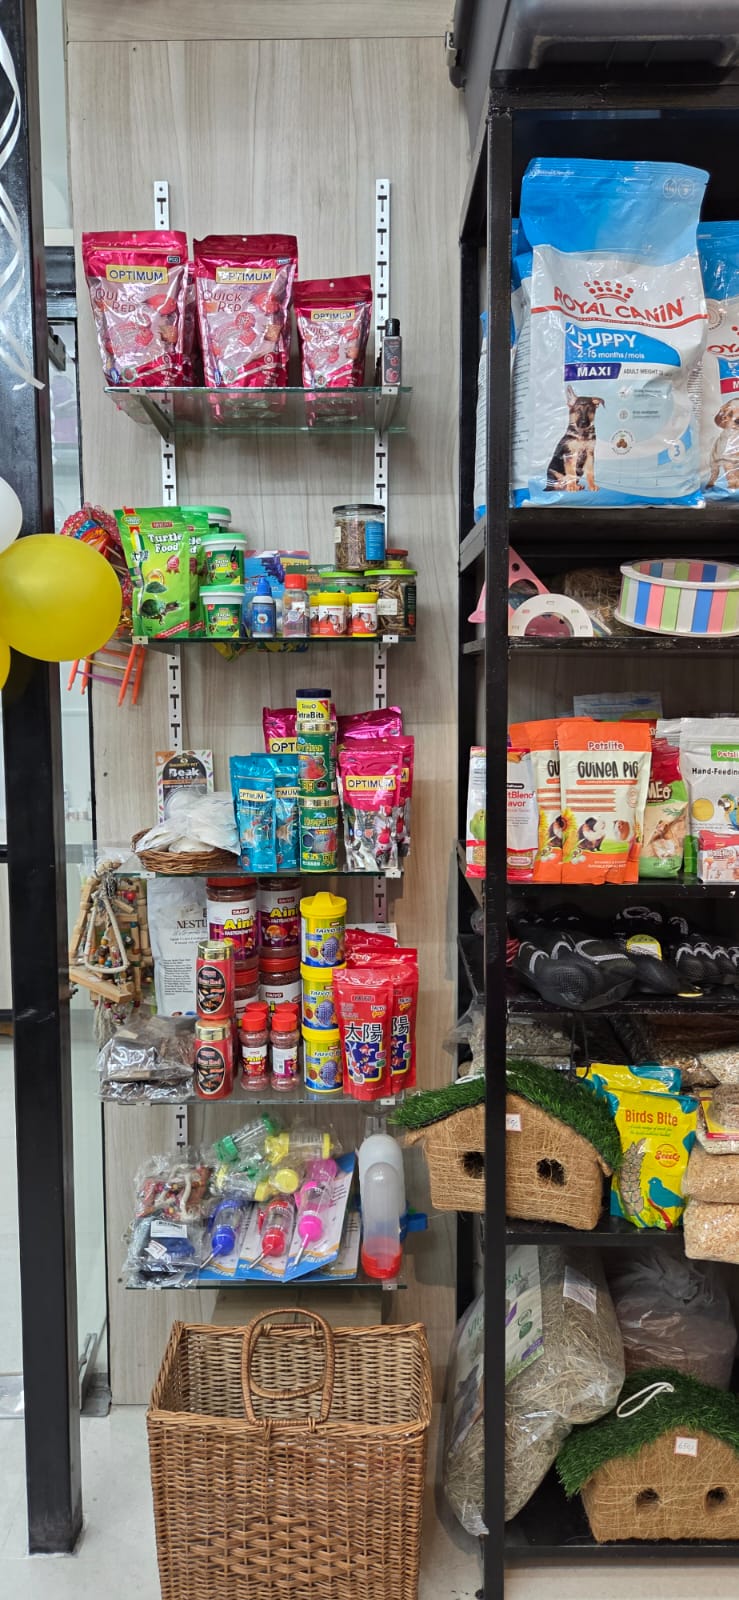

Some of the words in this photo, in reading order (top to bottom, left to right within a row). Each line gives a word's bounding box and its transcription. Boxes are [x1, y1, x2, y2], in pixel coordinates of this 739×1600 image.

[109, 269, 163, 281] OPTIMUM
[219, 271, 272, 281] OPTIMUM
[95, 287, 135, 302] QUICK
[203, 289, 242, 301] QUICK
[112, 303, 136, 313] RED
[217, 301, 242, 313] RED
[554, 286, 612, 317] ROYAL
[614, 298, 684, 323] CANIN
[577, 331, 637, 348] PUPPY
[577, 366, 611, 377] MAXI
[674, 445, 681, 457] 3
[148, 532, 182, 543] Turtle
[155, 543, 178, 553] Food
[588, 740, 624, 751] Petslite
[169, 767, 200, 778] Beak
[348, 778, 394, 788] OPTIMUM
[224, 915, 254, 931] Aini
[344, 1022, 382, 1042] 太陽
[625, 1109, 654, 1123] Birds
[657, 1111, 678, 1127] Bite
